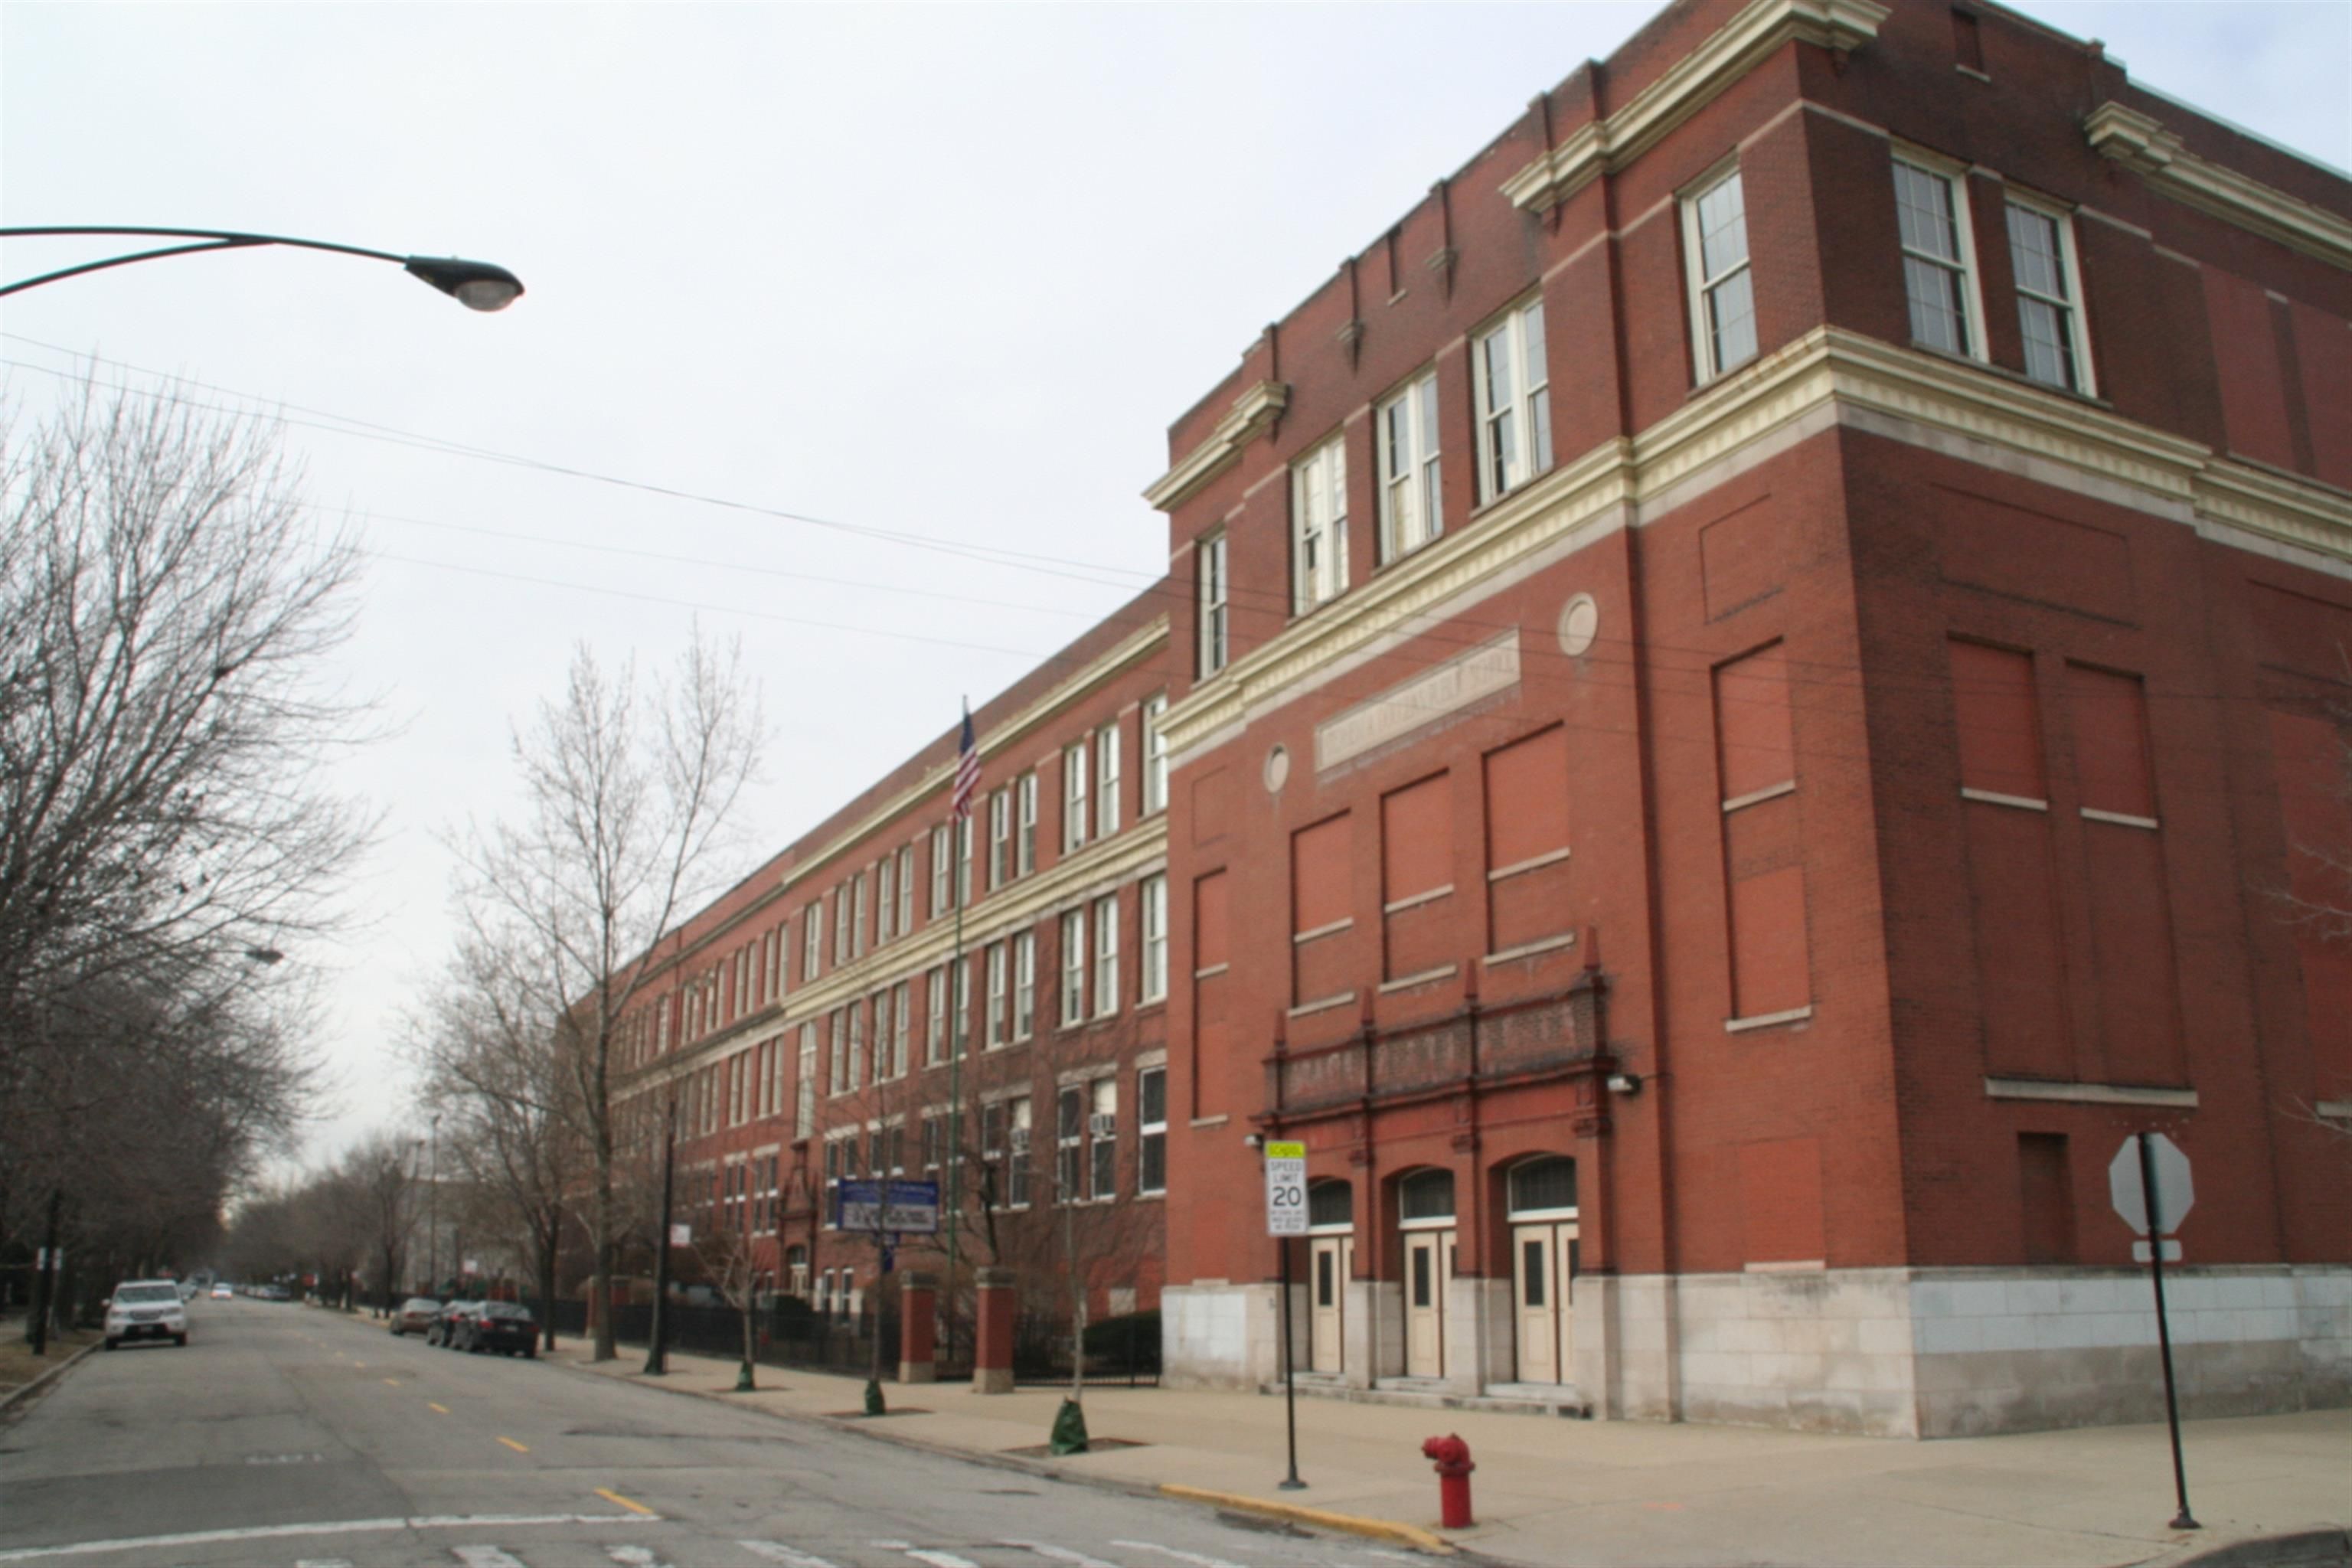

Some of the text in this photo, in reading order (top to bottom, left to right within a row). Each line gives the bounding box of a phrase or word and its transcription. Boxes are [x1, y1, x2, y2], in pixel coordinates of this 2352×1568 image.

[1271, 1161, 1302, 1171] SPEED
[1272, 1173, 1298, 1184] LIMIT
[1272, 1186, 1302, 1207] 20
